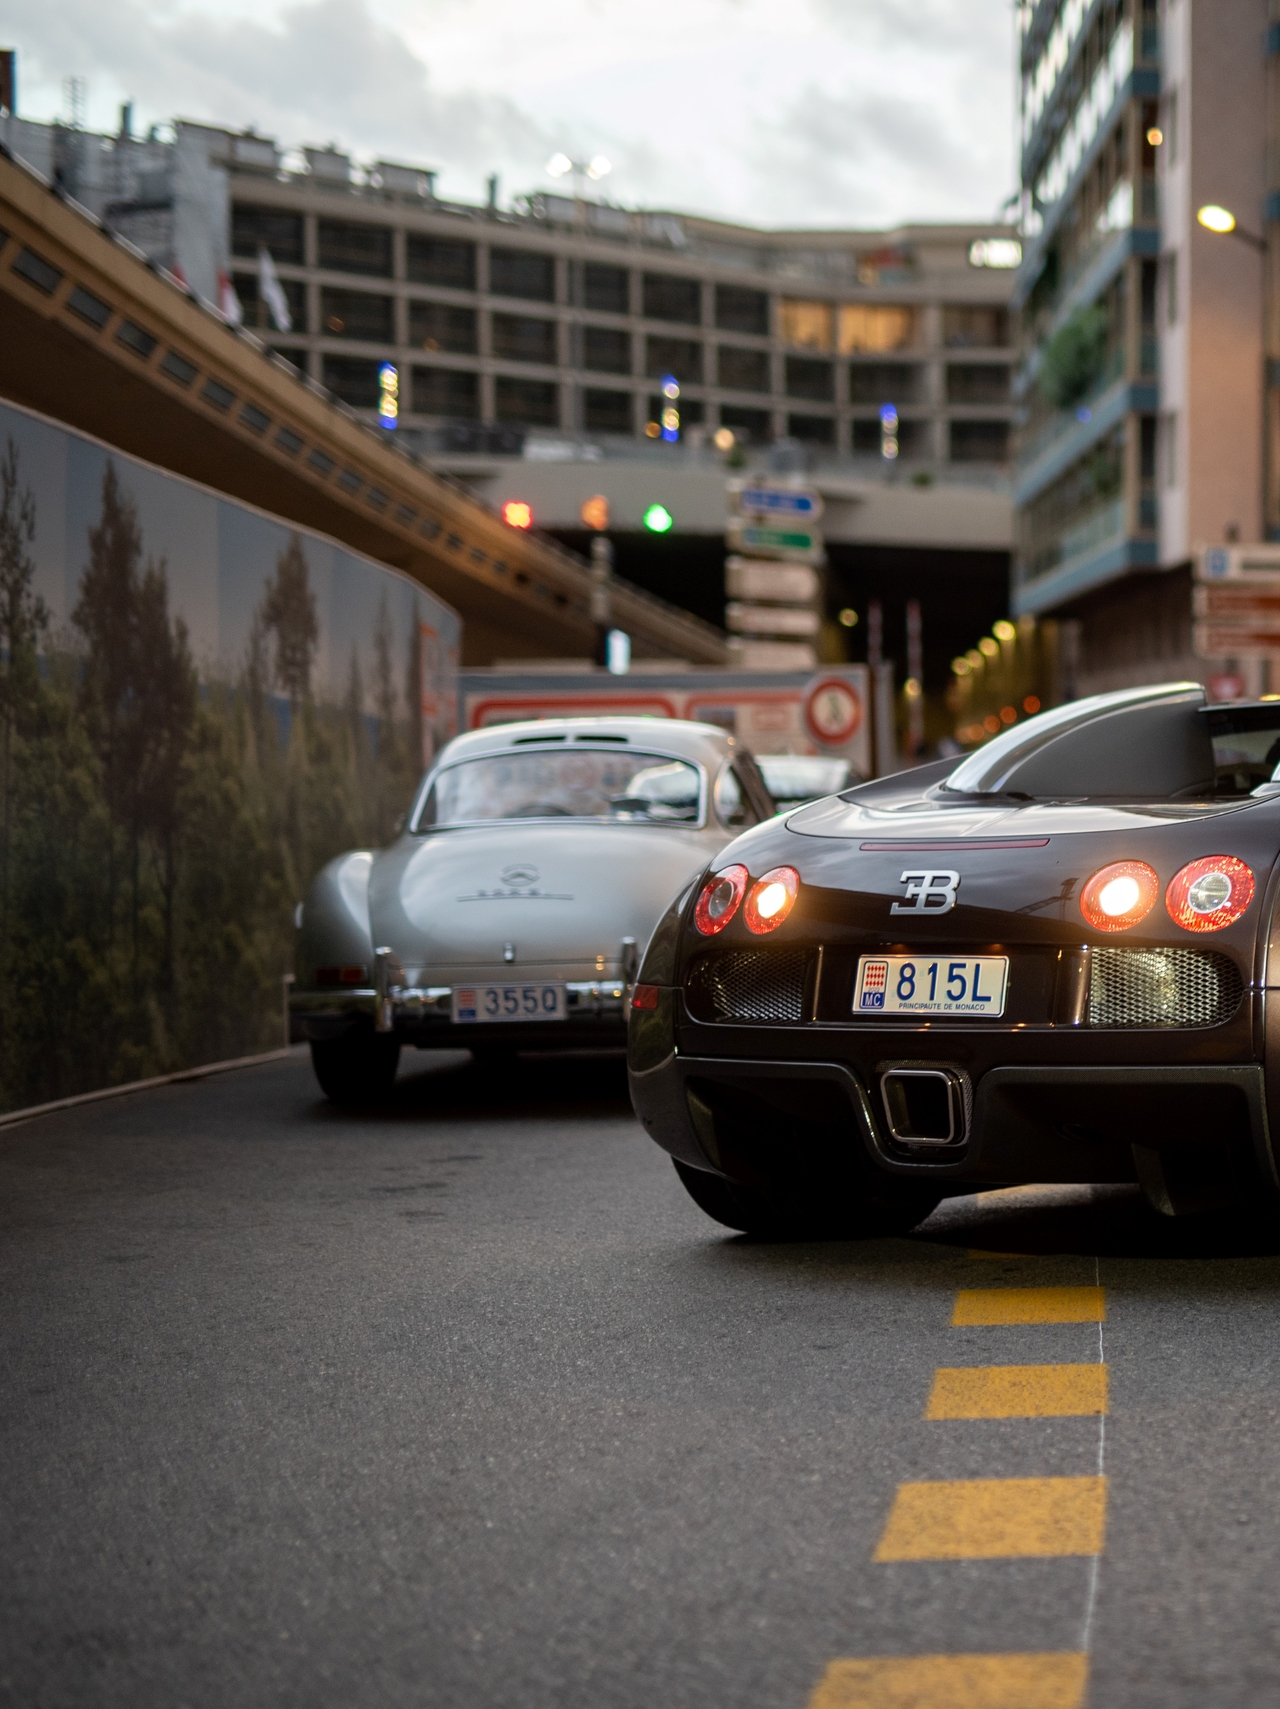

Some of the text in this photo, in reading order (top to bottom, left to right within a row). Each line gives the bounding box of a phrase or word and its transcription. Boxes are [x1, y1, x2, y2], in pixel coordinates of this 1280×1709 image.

[897, 962, 992, 1002] 815L
[865, 993, 881, 1006] MC
[898, 1002, 941, 1010] PRINCIPAUTE
